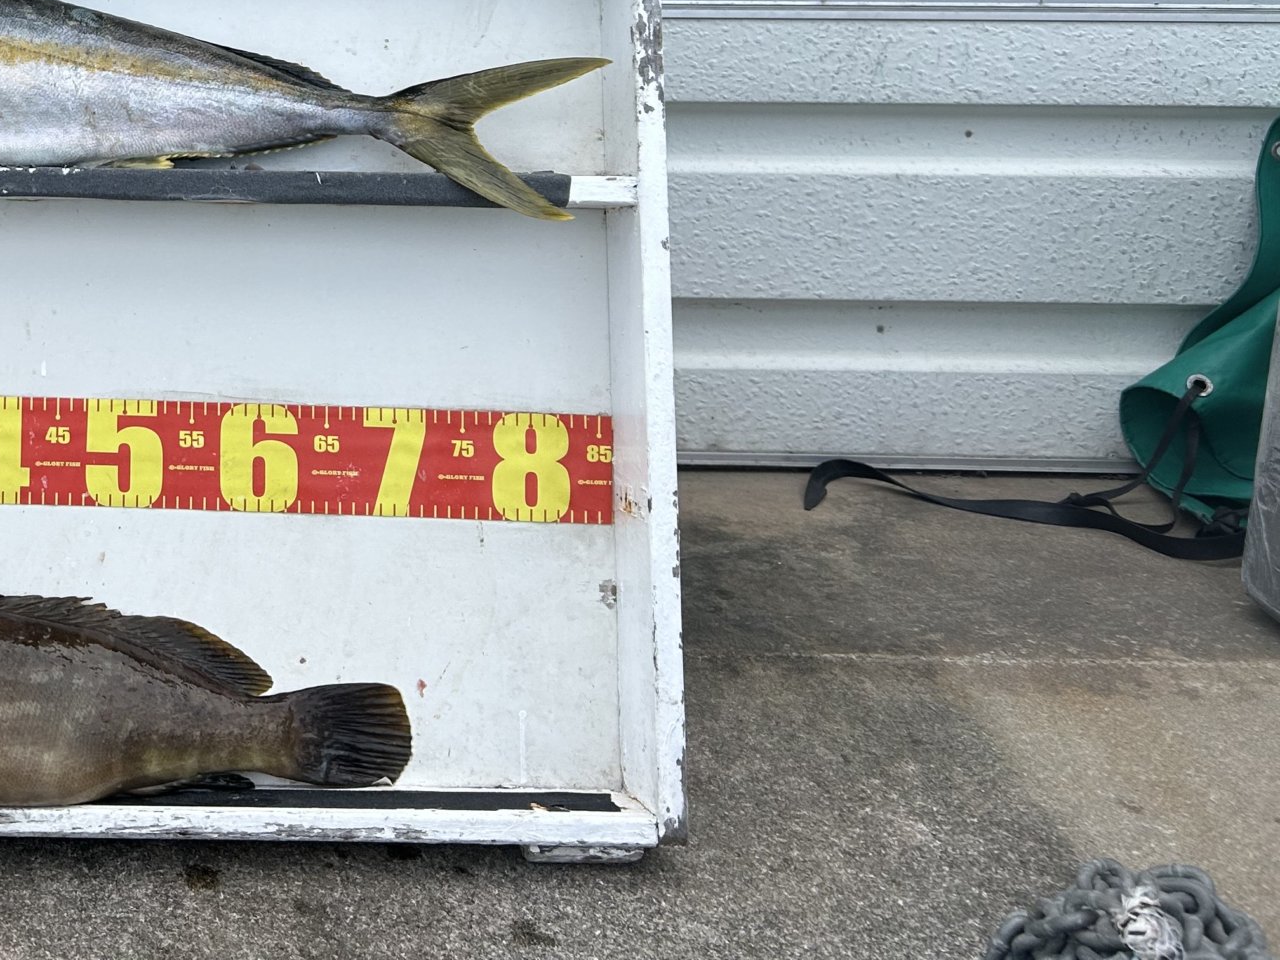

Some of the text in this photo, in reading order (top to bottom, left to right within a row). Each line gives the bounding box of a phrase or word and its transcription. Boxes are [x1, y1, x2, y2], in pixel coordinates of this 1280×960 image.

[45, 427, 71, 444] 45
[85, 399, 163, 507] 5
[179, 431, 205, 448] 55
[220, 404, 298, 512] 6
[313, 435, 340, 453] 65
[363, 407, 426, 516] 7
[451, 440, 475, 457] 75
[492, 412, 571, 522] 8
[586, 445, 612, 462] 85
